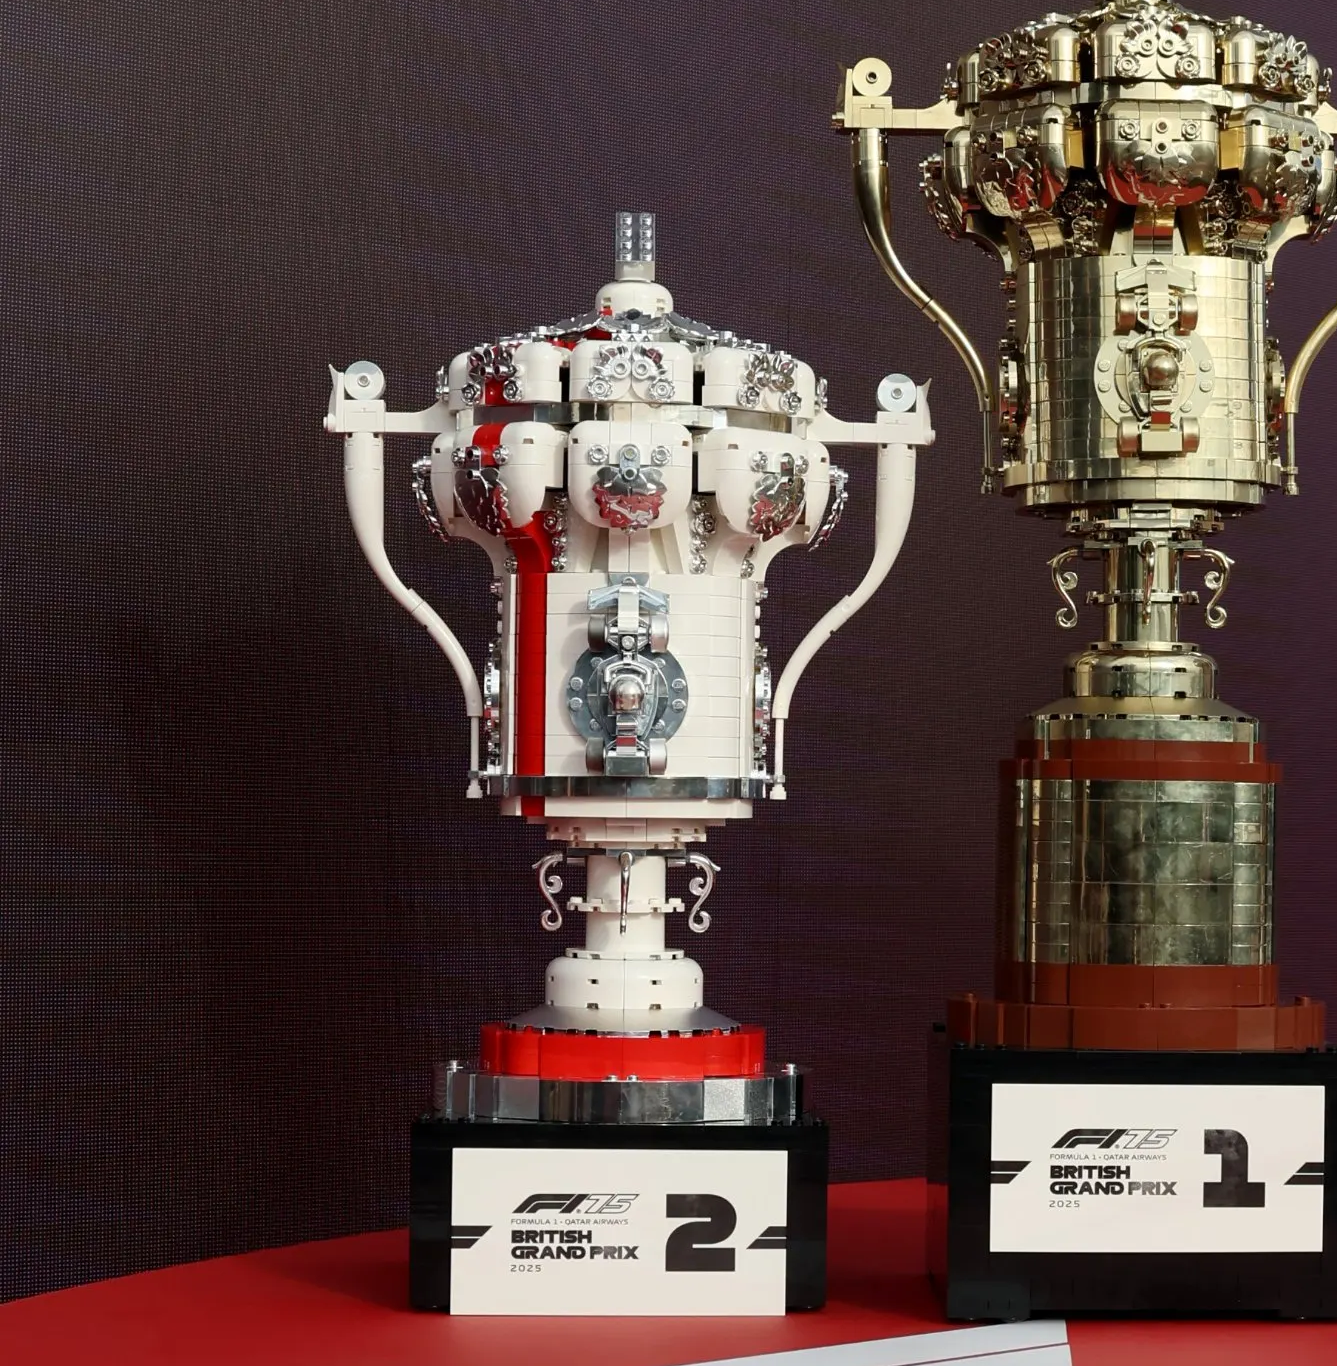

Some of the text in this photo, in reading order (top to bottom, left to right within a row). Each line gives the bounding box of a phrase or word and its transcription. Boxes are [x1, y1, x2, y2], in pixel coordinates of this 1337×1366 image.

[1049, 1153, 1090, 1161] FORMULA
[1103, 1154, 1130, 1162] QATAR
[1049, 1165, 1131, 1180] BRITISH
[1203, 1129, 1265, 1208] 1
[1049, 1181, 1178, 1196] GRAND PRIX
[1049, 1200, 1081, 1208] 2025
[511, 1230, 593, 1244] BRITISH
[665, 1193, 737, 1272] 2
[511, 1245, 640, 1260] GRAND PRIX
[510, 1264, 542, 1273] 2025
